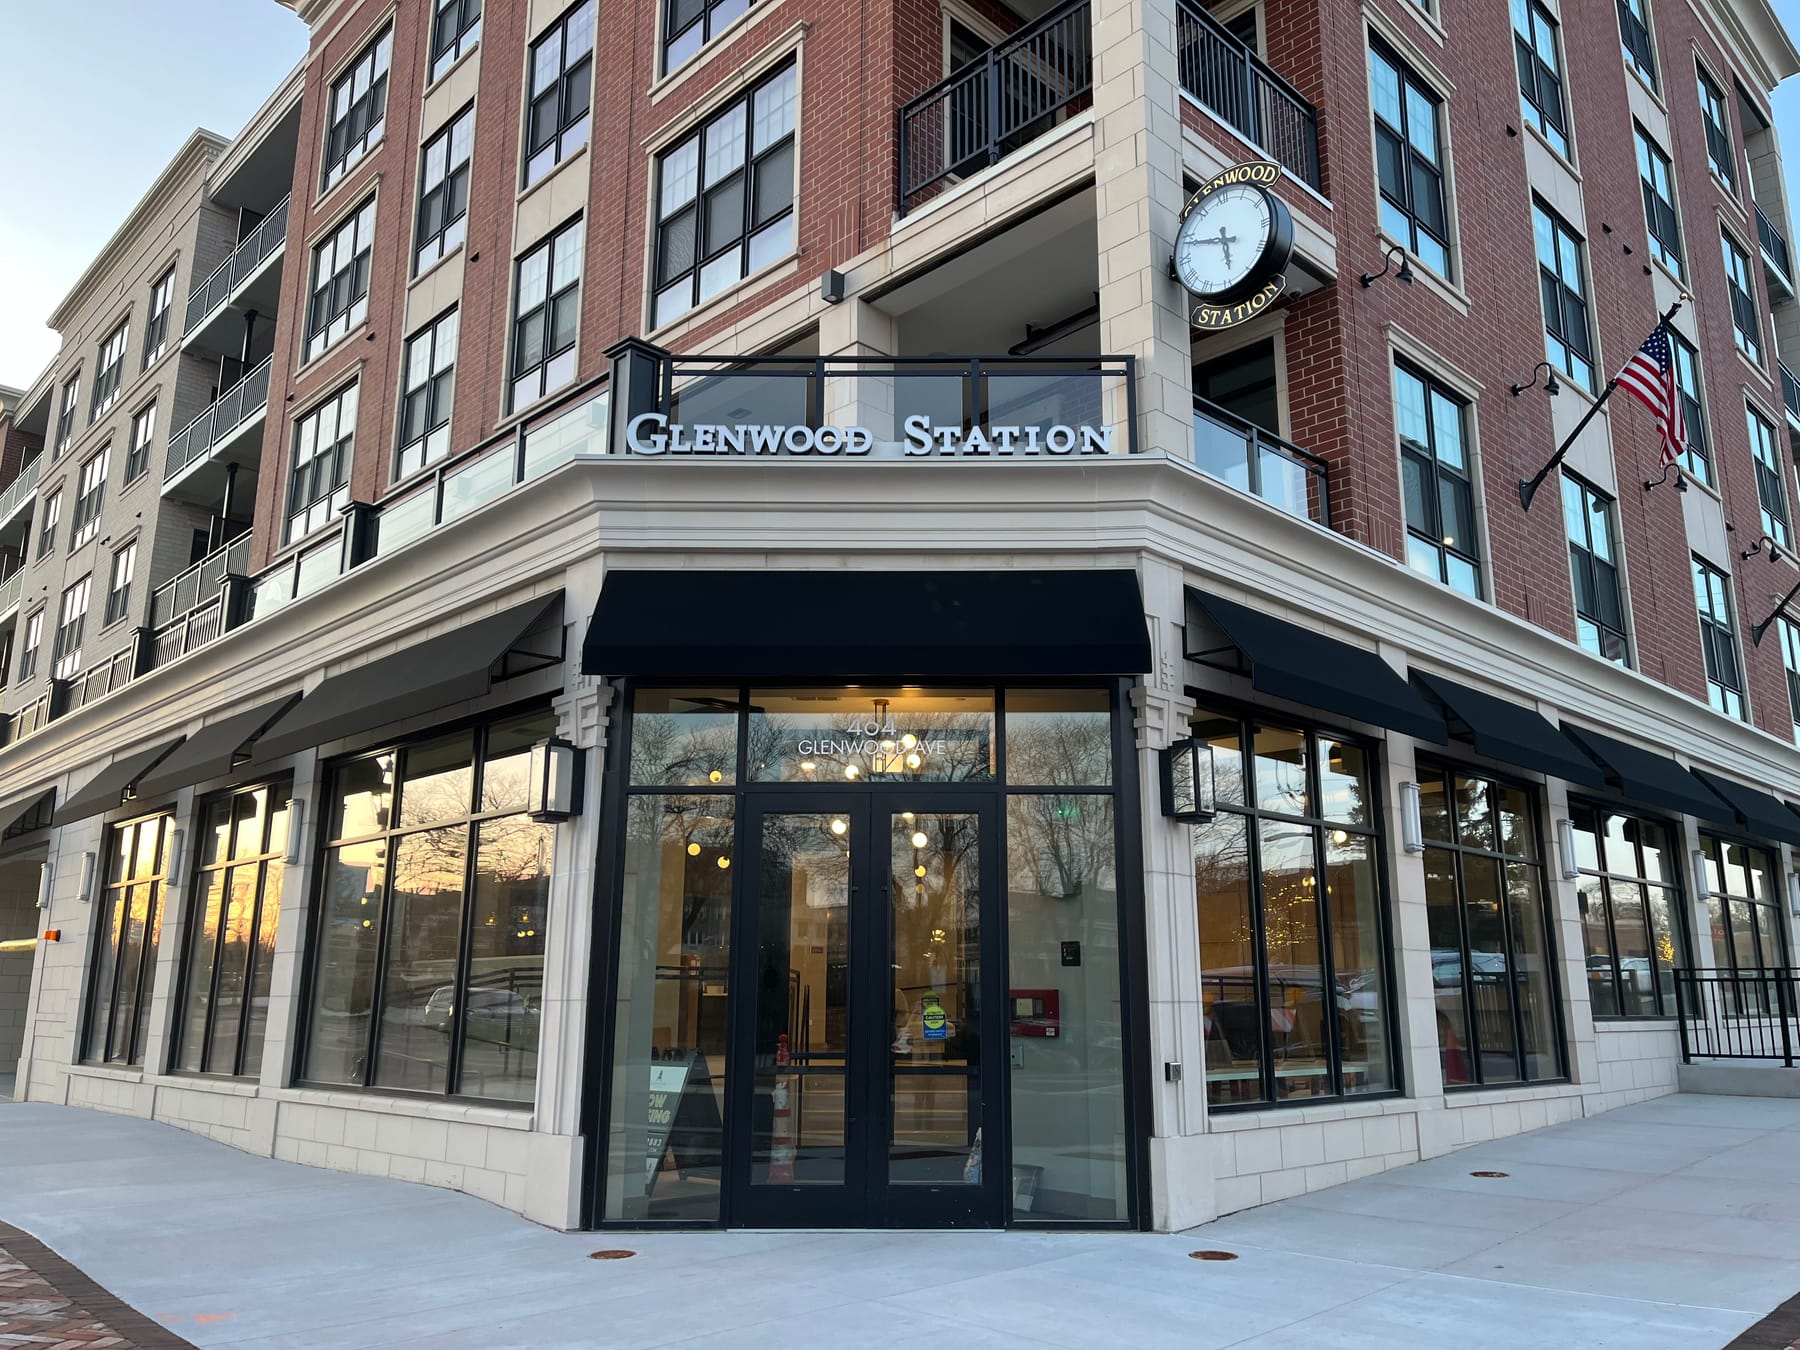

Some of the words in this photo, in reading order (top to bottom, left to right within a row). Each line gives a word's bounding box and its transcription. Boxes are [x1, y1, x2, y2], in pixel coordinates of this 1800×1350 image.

[1198, 281, 1278, 325] STATION
[846, 718, 897, 736] 404
[798, 740, 907, 755] GLENWOOD
[914, 740, 946, 755] AVE
[649, 1094, 668, 1108] OW
